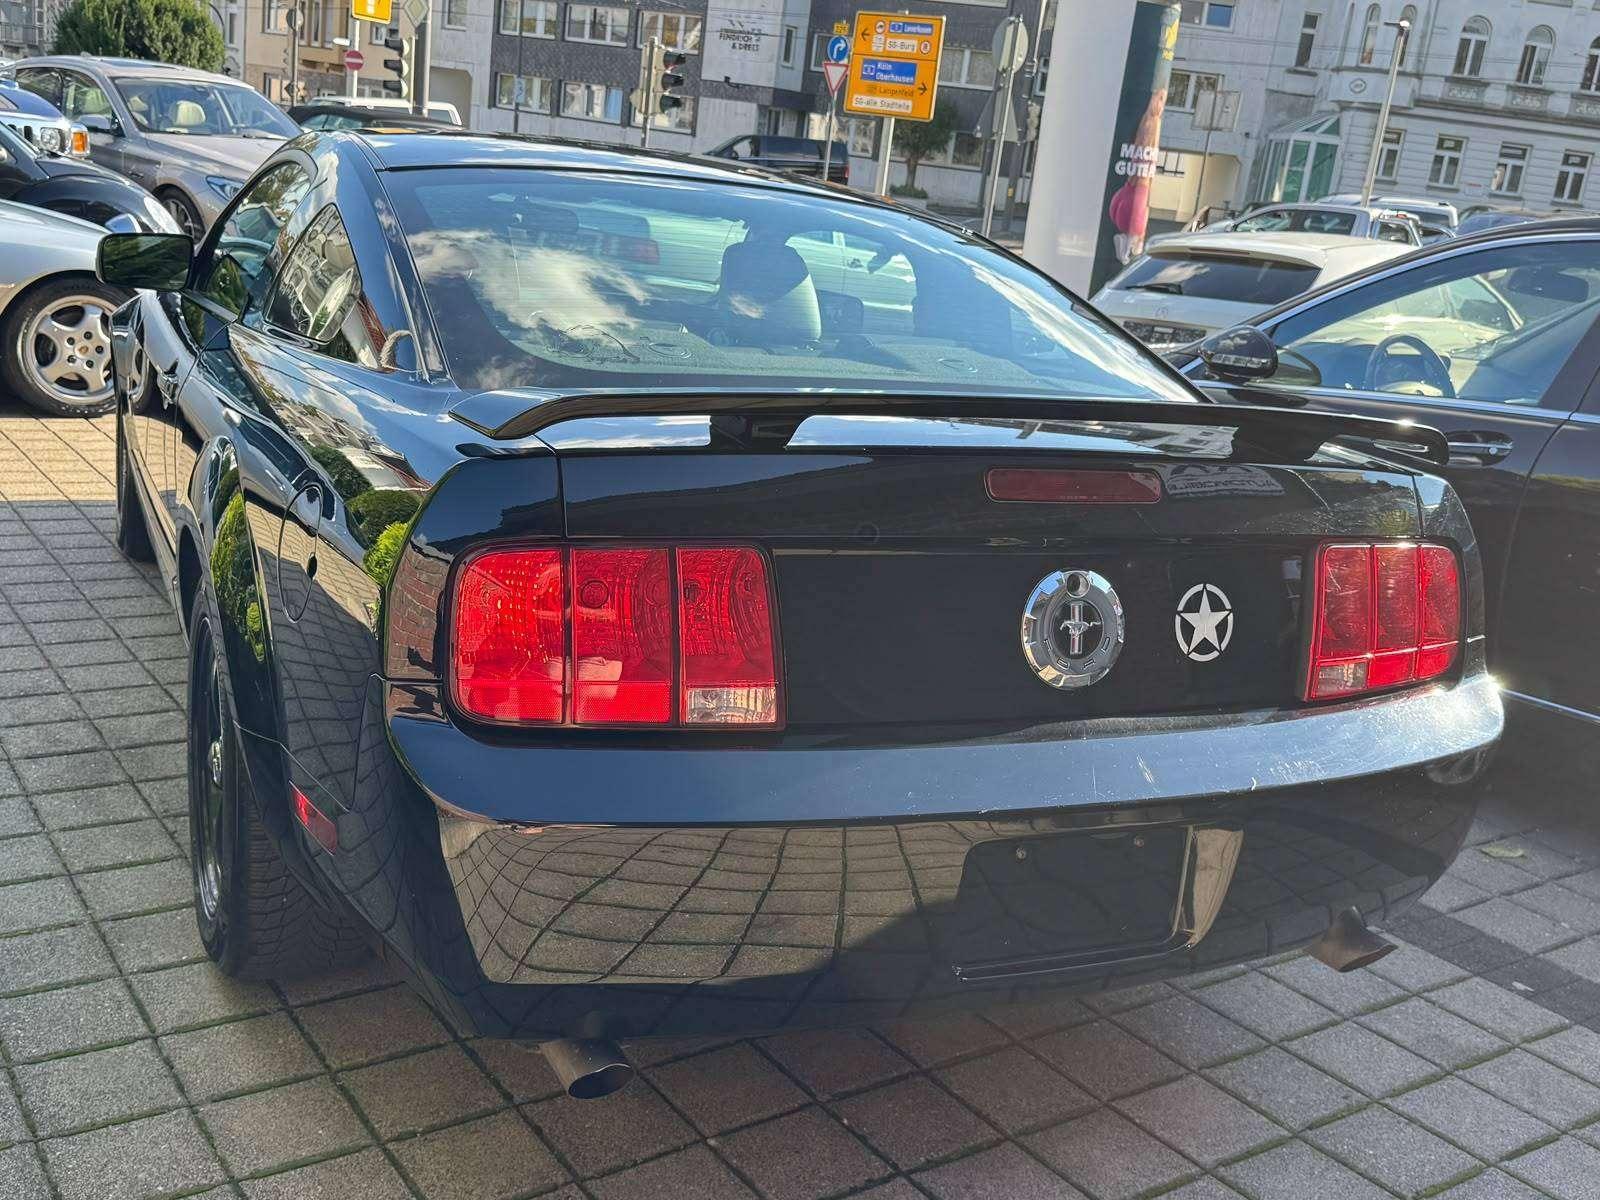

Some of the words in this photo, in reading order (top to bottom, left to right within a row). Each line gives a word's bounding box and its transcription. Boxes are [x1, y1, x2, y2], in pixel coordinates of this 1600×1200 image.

[887, 41, 915, 52] SG-Burg
[876, 72, 914, 83] Oberhausen
[880, 87, 914, 97] Langenfeld
